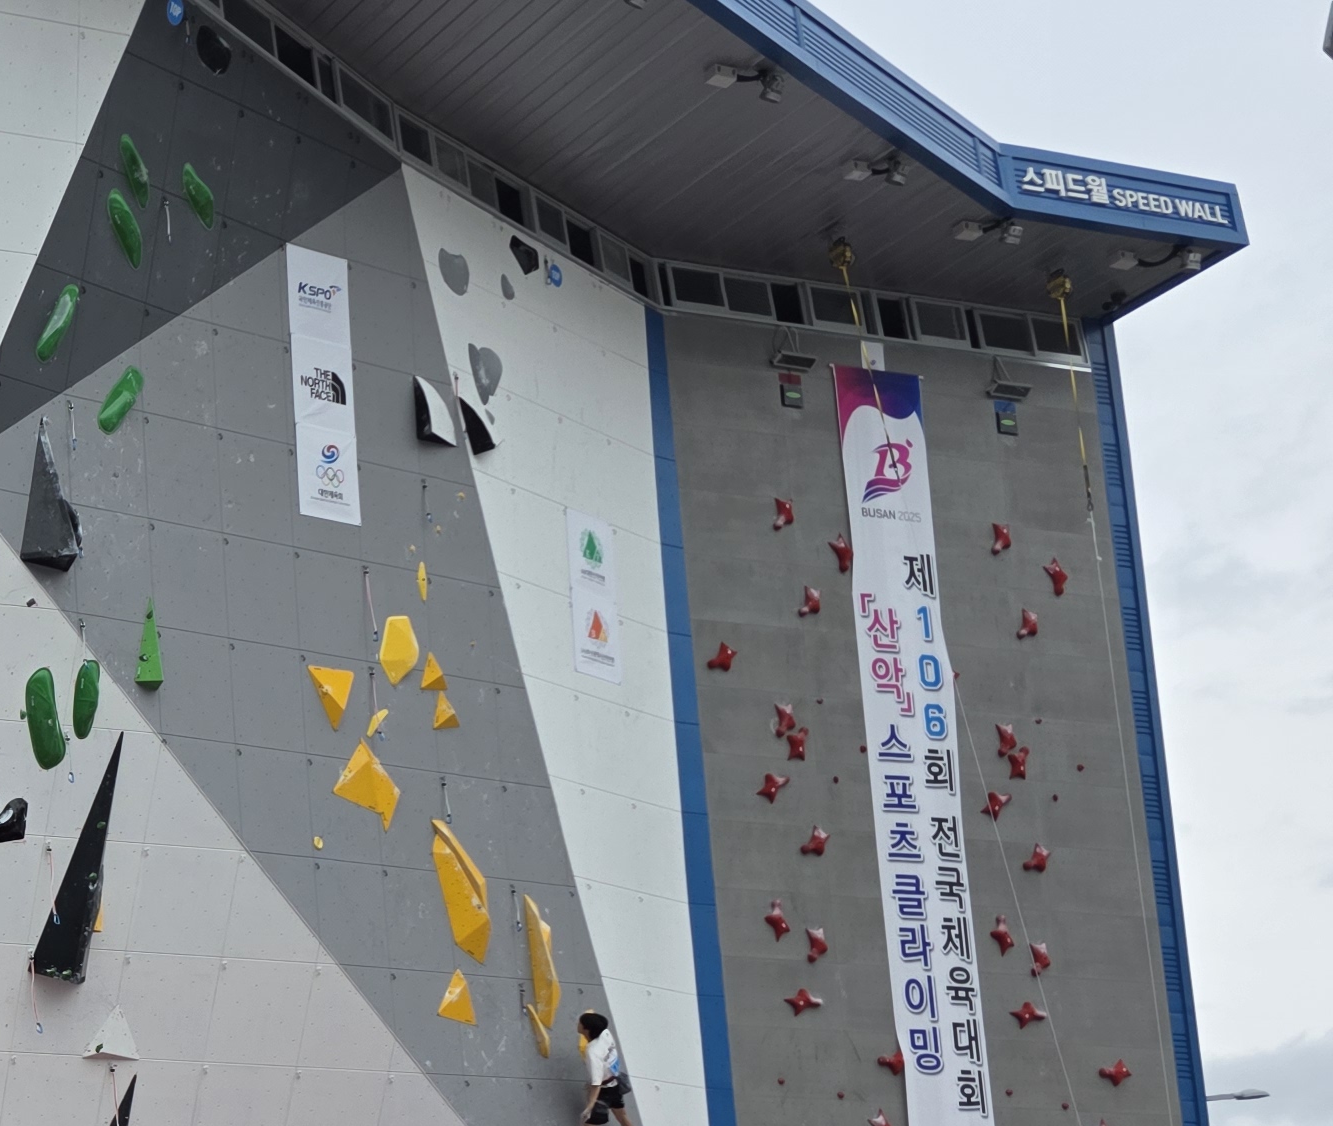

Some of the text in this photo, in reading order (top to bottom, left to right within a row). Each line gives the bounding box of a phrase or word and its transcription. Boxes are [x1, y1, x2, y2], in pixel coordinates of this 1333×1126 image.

[1021, 167, 1229, 224] 스피드월 SPEED WALL
[298, 281, 332, 300] KSPO
[313, 367, 332, 381] THE
[300, 375, 332, 391] NORTH
[310, 388, 332, 402] FACE
[861, 507, 921, 523] BUSAN 2025
[929, 815, 989, 1118] 전국체육대회
